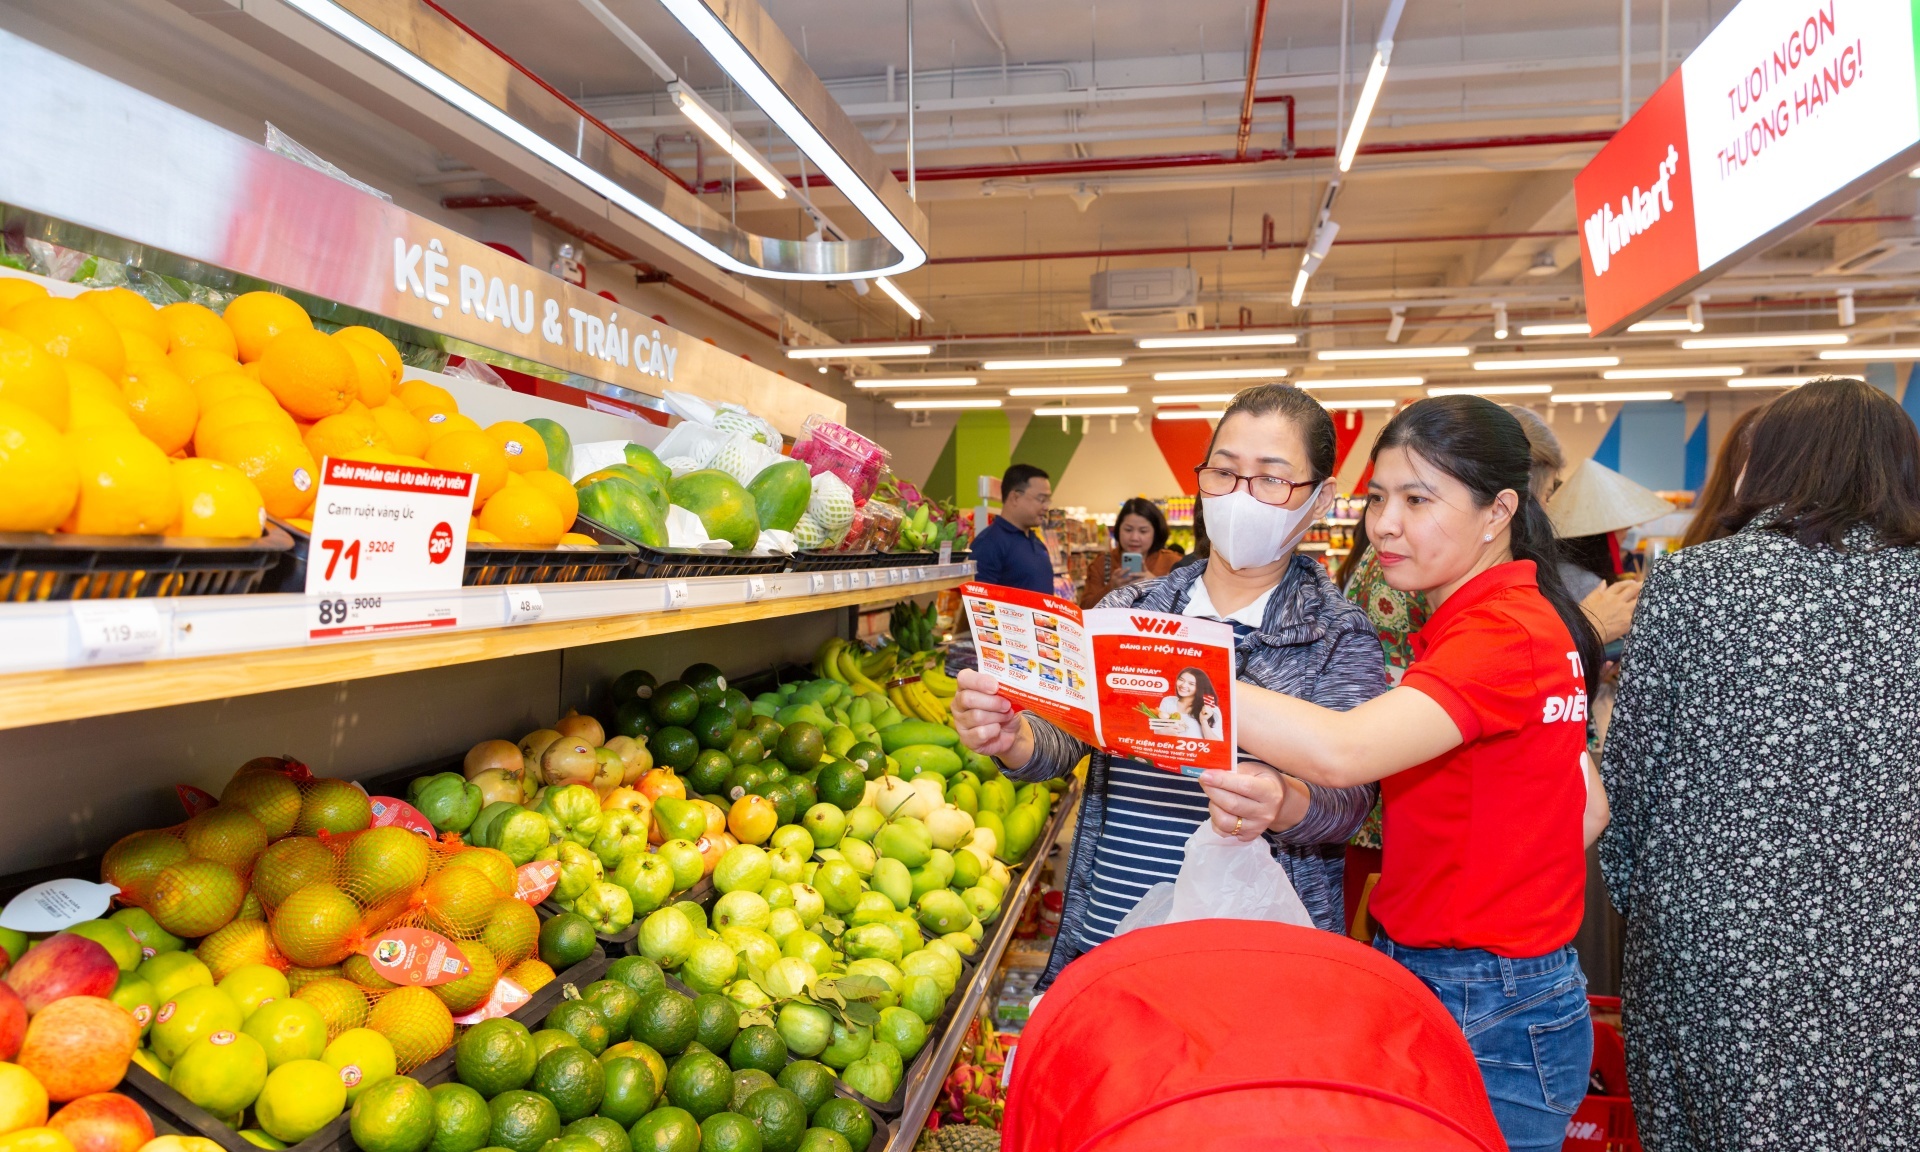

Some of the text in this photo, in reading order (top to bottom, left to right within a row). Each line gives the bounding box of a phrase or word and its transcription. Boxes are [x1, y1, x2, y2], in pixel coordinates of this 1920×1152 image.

[1773, 0, 1835, 85] NGON
[394, 237, 678, 382] KỆ RAU & TRÁI CÂY
[328, 502, 351, 516] Cam
[354, 503, 374, 519] ruột
[378, 505, 400, 521] vàng
[430, 537, 452, 554] 20%
[321, 539, 361, 581] 71
[319, 599, 347, 625] 89
[1130, 615, 1182, 636] WiN
[1154, 644, 1174, 655] HỘI
[1177, 647, 1203, 658] VIÊN
[1112, 665, 1135, 674] NHẬN
[1566, 651, 1585, 678] T
[1112, 677, 1163, 689] 50.000Đ
[1136, 739, 1155, 747] KIỆM
[1157, 740, 1175, 749] ĐẾN
[1175, 739, 1211, 753] 20%
